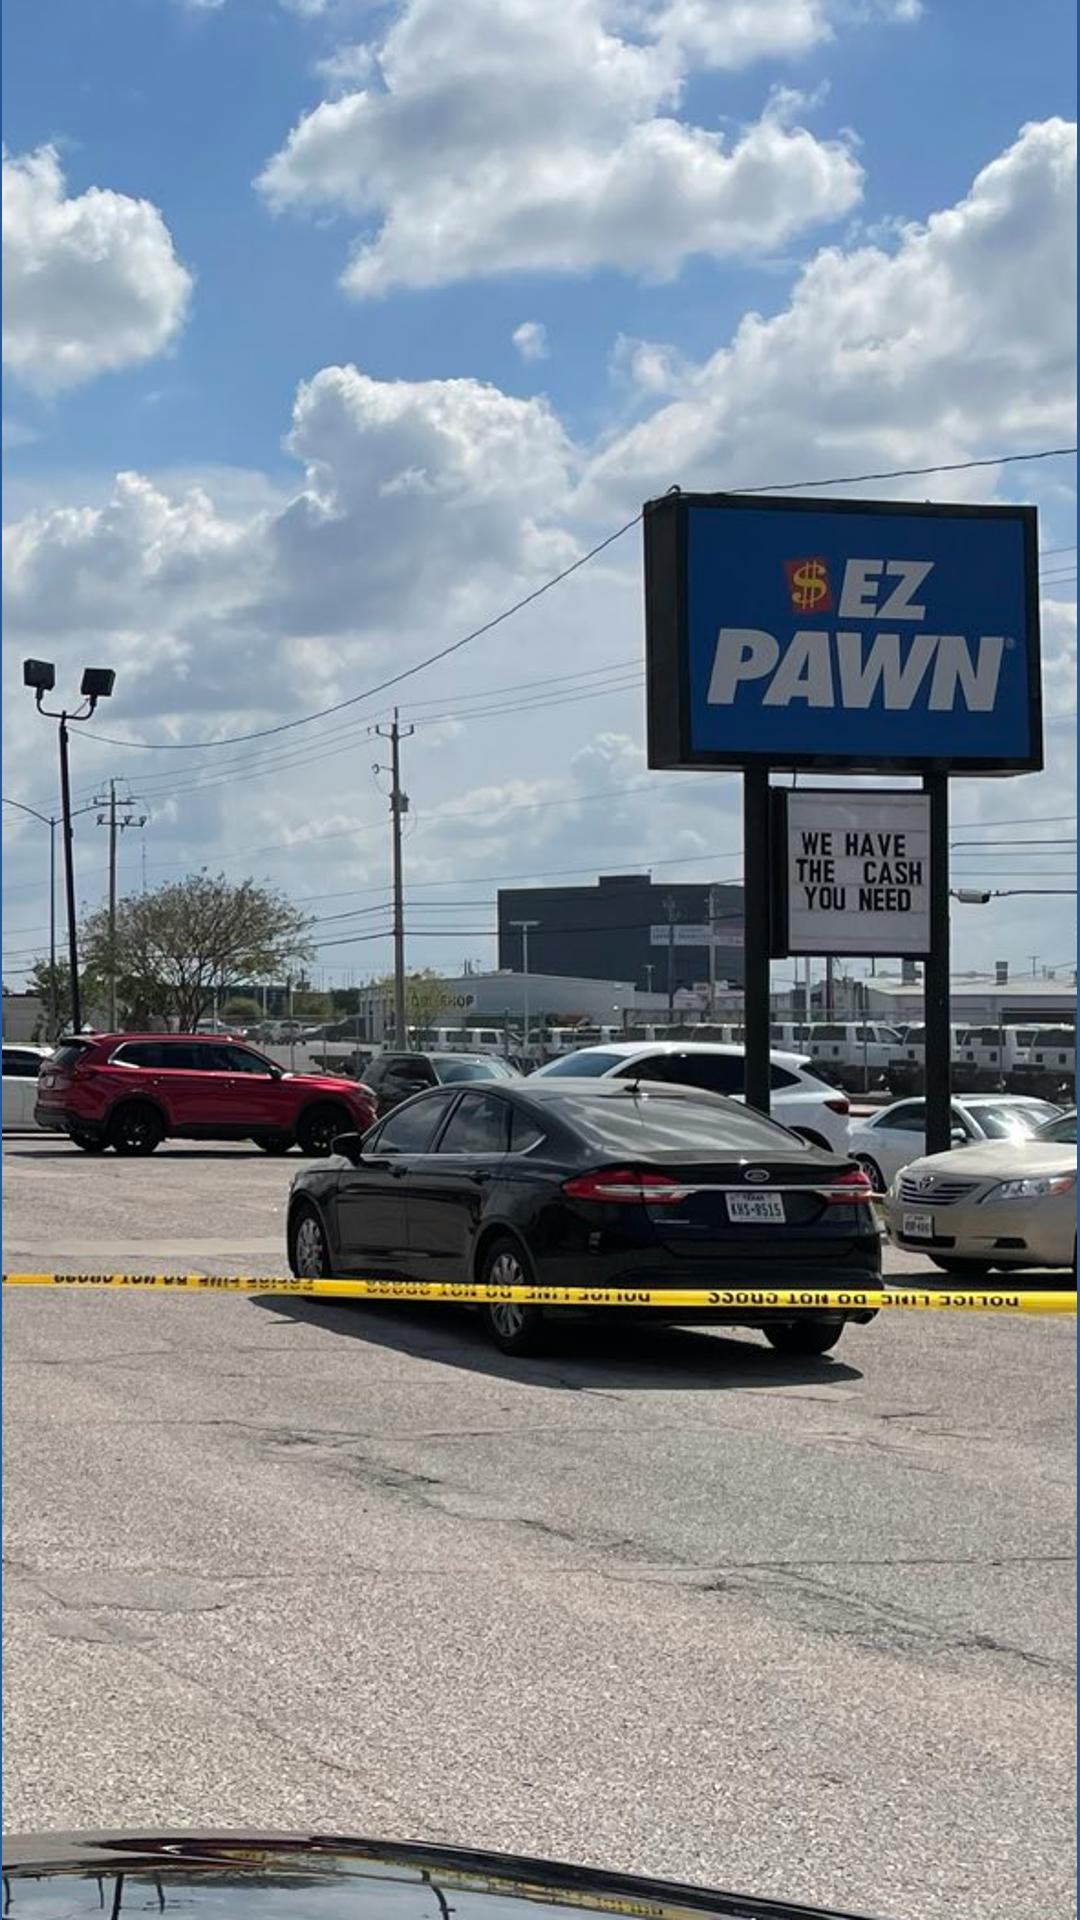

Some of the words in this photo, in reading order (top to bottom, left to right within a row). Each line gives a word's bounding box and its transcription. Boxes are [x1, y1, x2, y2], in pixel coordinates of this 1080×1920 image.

[838, 559, 935, 620] EZ
[707, 628, 1005, 712] PAWN
[802, 832, 832, 856] WE
[845, 832, 906, 858] HAVE
[795, 859, 835, 883] THE
[863, 861, 922, 885] CASH
[804, 886, 846, 910] YOU
[859, 888, 911, 912] NEED
[786, 1292, 829, 1306] NOT
[837, 1292, 868, 1306] DO
